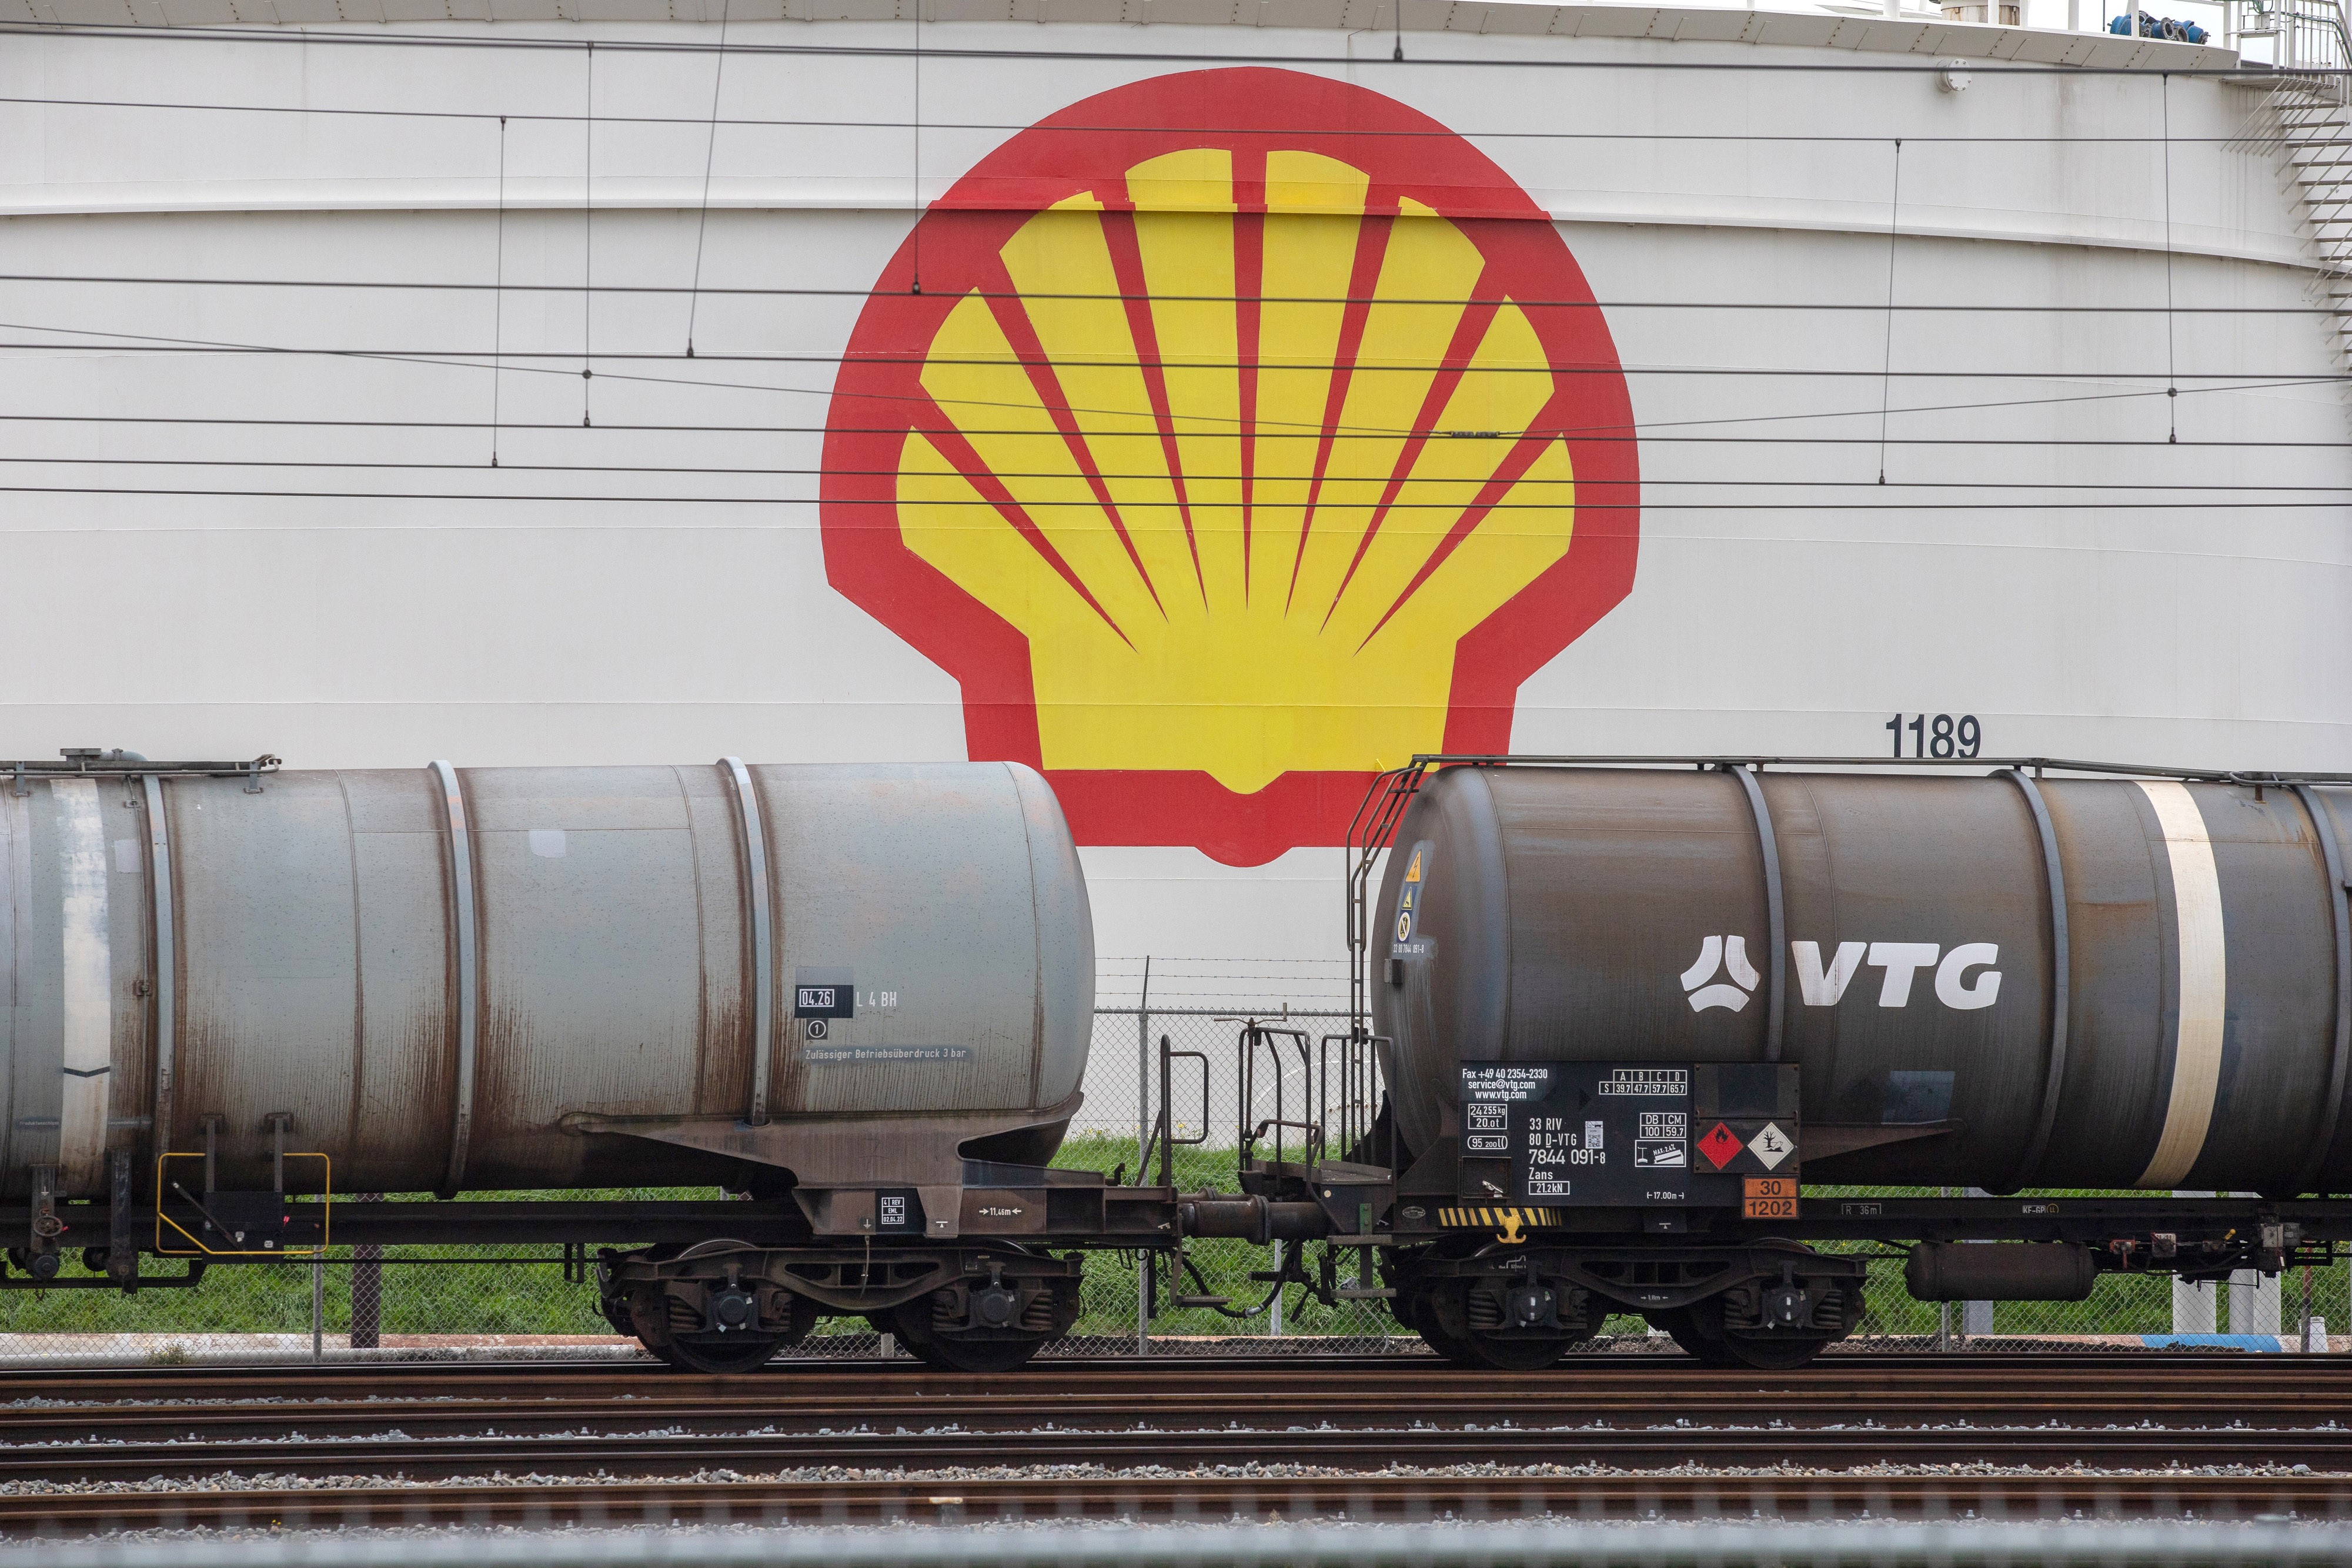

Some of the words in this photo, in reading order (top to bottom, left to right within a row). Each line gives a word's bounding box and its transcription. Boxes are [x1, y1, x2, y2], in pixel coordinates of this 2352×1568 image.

[1886, 713, 1981, 758] 1189
[1791, 941, 2002, 1010] VTG
[802, 991, 831, 1006] 04.26
[856, 992, 863, 1007] L
[868, 992, 876, 1006] 4
[881, 991, 897, 1007] BH
[806, 1049, 853, 1061] Zulässiger
[855, 1048, 940, 1059] Betriebsüberdruck
[943, 1048, 948, 1057] 3
[951, 1048, 967, 1057] bar
[1462, 1068, 1476, 1079] Fax
[1478, 1068, 1494, 1079] +49
[1495, 1068, 1506, 1079] 40
[1507, 1068, 1548, 1079] 2354-2330
[1620, 1071, 1626, 1081] A
[1639, 1072, 1643, 1081] B
[1657, 1072, 1662, 1081] C
[1675, 1072, 1680, 1081] D
[1468, 1079, 1536, 1091] service@vtg.com
[1604, 1084, 1609, 1093] S
[1616, 1084, 1631, 1094] 39.7
[1634, 1084, 1648, 1094] 47.7
[1652, 1084, 1666, 1094] 57.7
[1670, 1084, 1685, 1094] 65.7
[1475, 1091, 1527, 1101] www.vtg.com
[1471, 1106, 1482, 1116] 24
[1484, 1106, 1496, 1115] 255
[1529, 1118, 1542, 1131] 33
[1546, 1118, 1562, 1131] RIV
[1646, 1115, 1659, 1125] DB
[1668, 1115, 1682, 1125] CM
[1645, 1126, 1660, 1136] 100
[1666, 1126, 1683, 1136] 59.7
[1472, 1138, 1482, 1148] 95
[1529, 1133, 1541, 1146] 80
[1546, 1133, 1577, 1148] D-VTG
[1529, 1149, 1565, 1164] 7844
[1571, 1149, 1606, 1165] 091-8
[1529, 1167, 1553, 1180] Zans
[1760, 1181, 1781, 1195] 30
[1749, 1201, 1792, 1216] 1202
[1846, 1205, 1852, 1215] R
[1860, 1205, 1877, 1215] 36m
